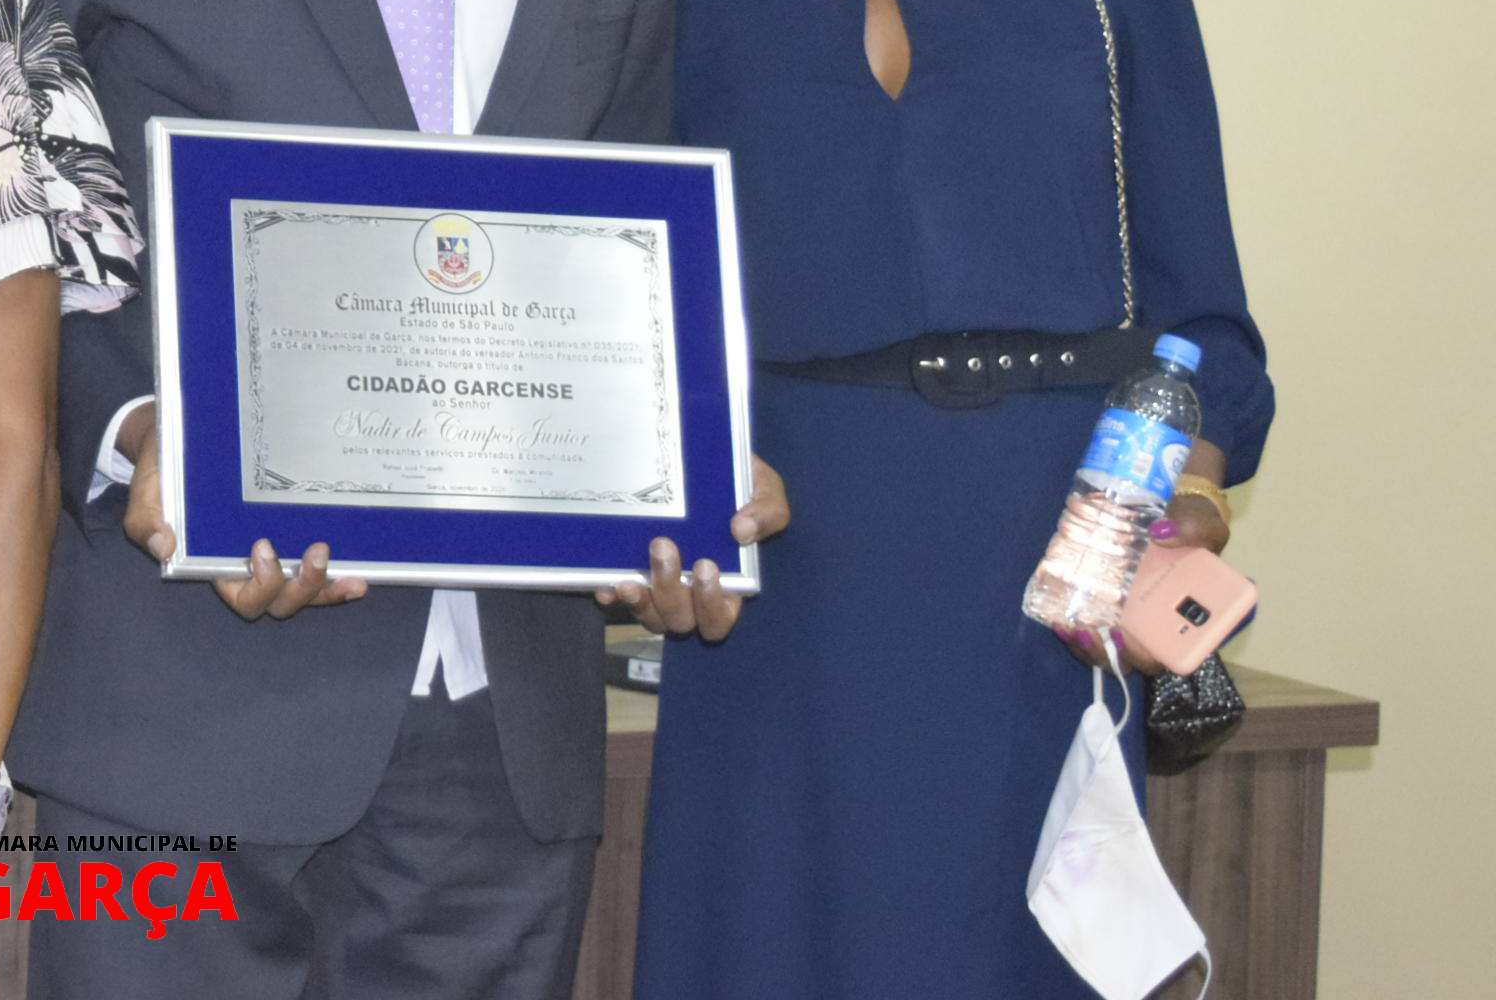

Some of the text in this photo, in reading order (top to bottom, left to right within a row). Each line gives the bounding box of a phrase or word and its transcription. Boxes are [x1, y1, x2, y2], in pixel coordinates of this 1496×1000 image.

[334, 291, 577, 326] Câmara Municipal de Garça
[399, 316, 515, 332] Estado de São Paulo
[369, 331, 381, 341] de
[474, 336, 486, 346] do
[488, 336, 525, 347] Decreto
[460, 348, 472, 358] do
[346, 374, 574, 401] CIDADÃO GARCENSE
[432, 398, 492, 409] ao Senhor
[333, 407, 590, 452] Nadir de Campos Junior
[342, 446, 369, 456] pelos
[372, 446, 422, 457] relevantes
[424, 447, 465, 459] serviços
[467, 450, 515, 461] prestados
